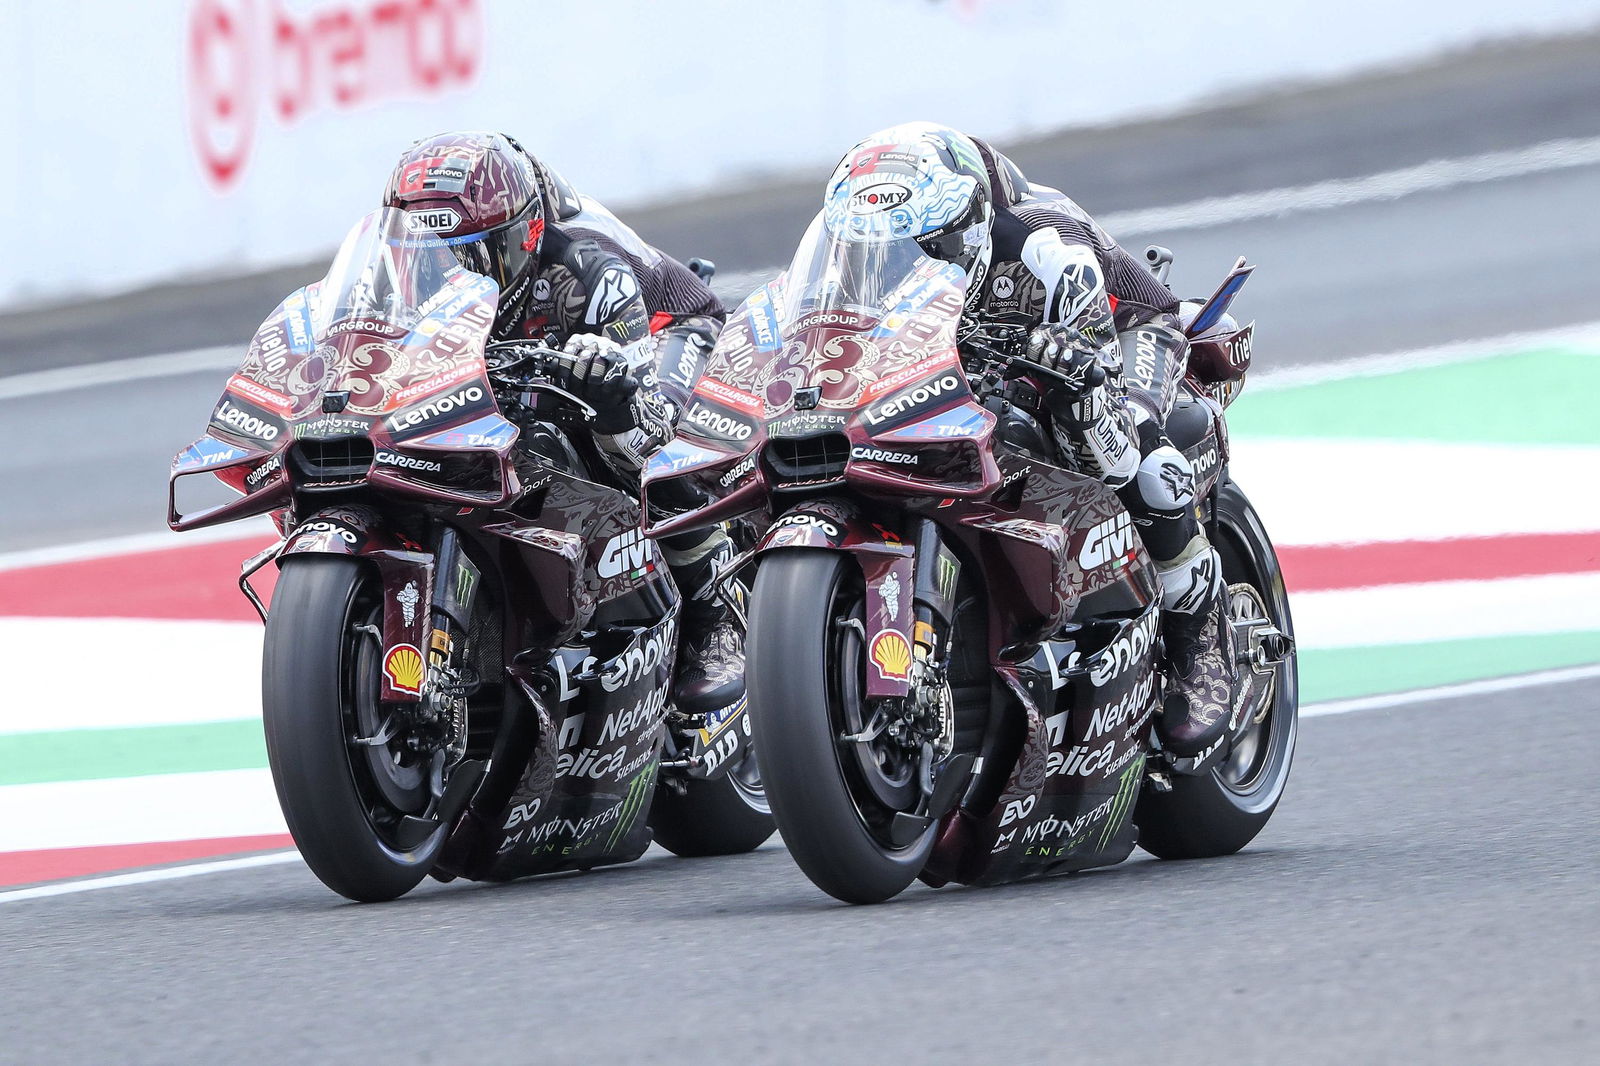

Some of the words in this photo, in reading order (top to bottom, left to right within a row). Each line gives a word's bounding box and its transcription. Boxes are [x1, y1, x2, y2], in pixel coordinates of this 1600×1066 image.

[428, 167, 463, 178] Lenovo
[880, 152, 916, 162] Lenovo
[852, 192, 907, 207] SUOMY
[410, 212, 453, 230] SHOEI
[916, 228, 944, 243] CARRERA
[497, 276, 530, 317] Lenovo
[259, 325, 288, 372] riello
[1127, 330, 1156, 391] Lenovo
[280, 342, 411, 421] 93
[395, 362, 482, 400] FRECCIAROSSA
[752, 334, 880, 420] 63
[869, 352, 955, 393] FRECCIAROSSA
[388, 387, 483, 432] Lenovo
[864, 375, 959, 426] Lenovo
[216, 401, 278, 440] Lenovo
[686, 402, 752, 440] Lenovo
[938, 424, 973, 436] TIM
[202, 449, 233, 466] TIM
[851, 447, 919, 465] CARRERA
[1097, 420, 1129, 461] Unipol
[246, 458, 280, 485] CARRERA
[375, 451, 441, 472] CARRERA
[672, 453, 704, 470] TIM
[719, 458, 755, 487] CARRERA
[1003, 465, 1031, 487] port
[1190, 448, 1217, 476] novo
[522, 474, 552, 496] port
[288, 521, 357, 544] enovo
[764, 514, 838, 537] enovo
[1078, 510, 1134, 570] GIVI
[597, 527, 653, 579] GIVI
[1083, 671, 1154, 742] NetApp
[556, 745, 627, 779] elica
[703, 729, 738, 777] D.I.D
[1046, 739, 1115, 778] elica
